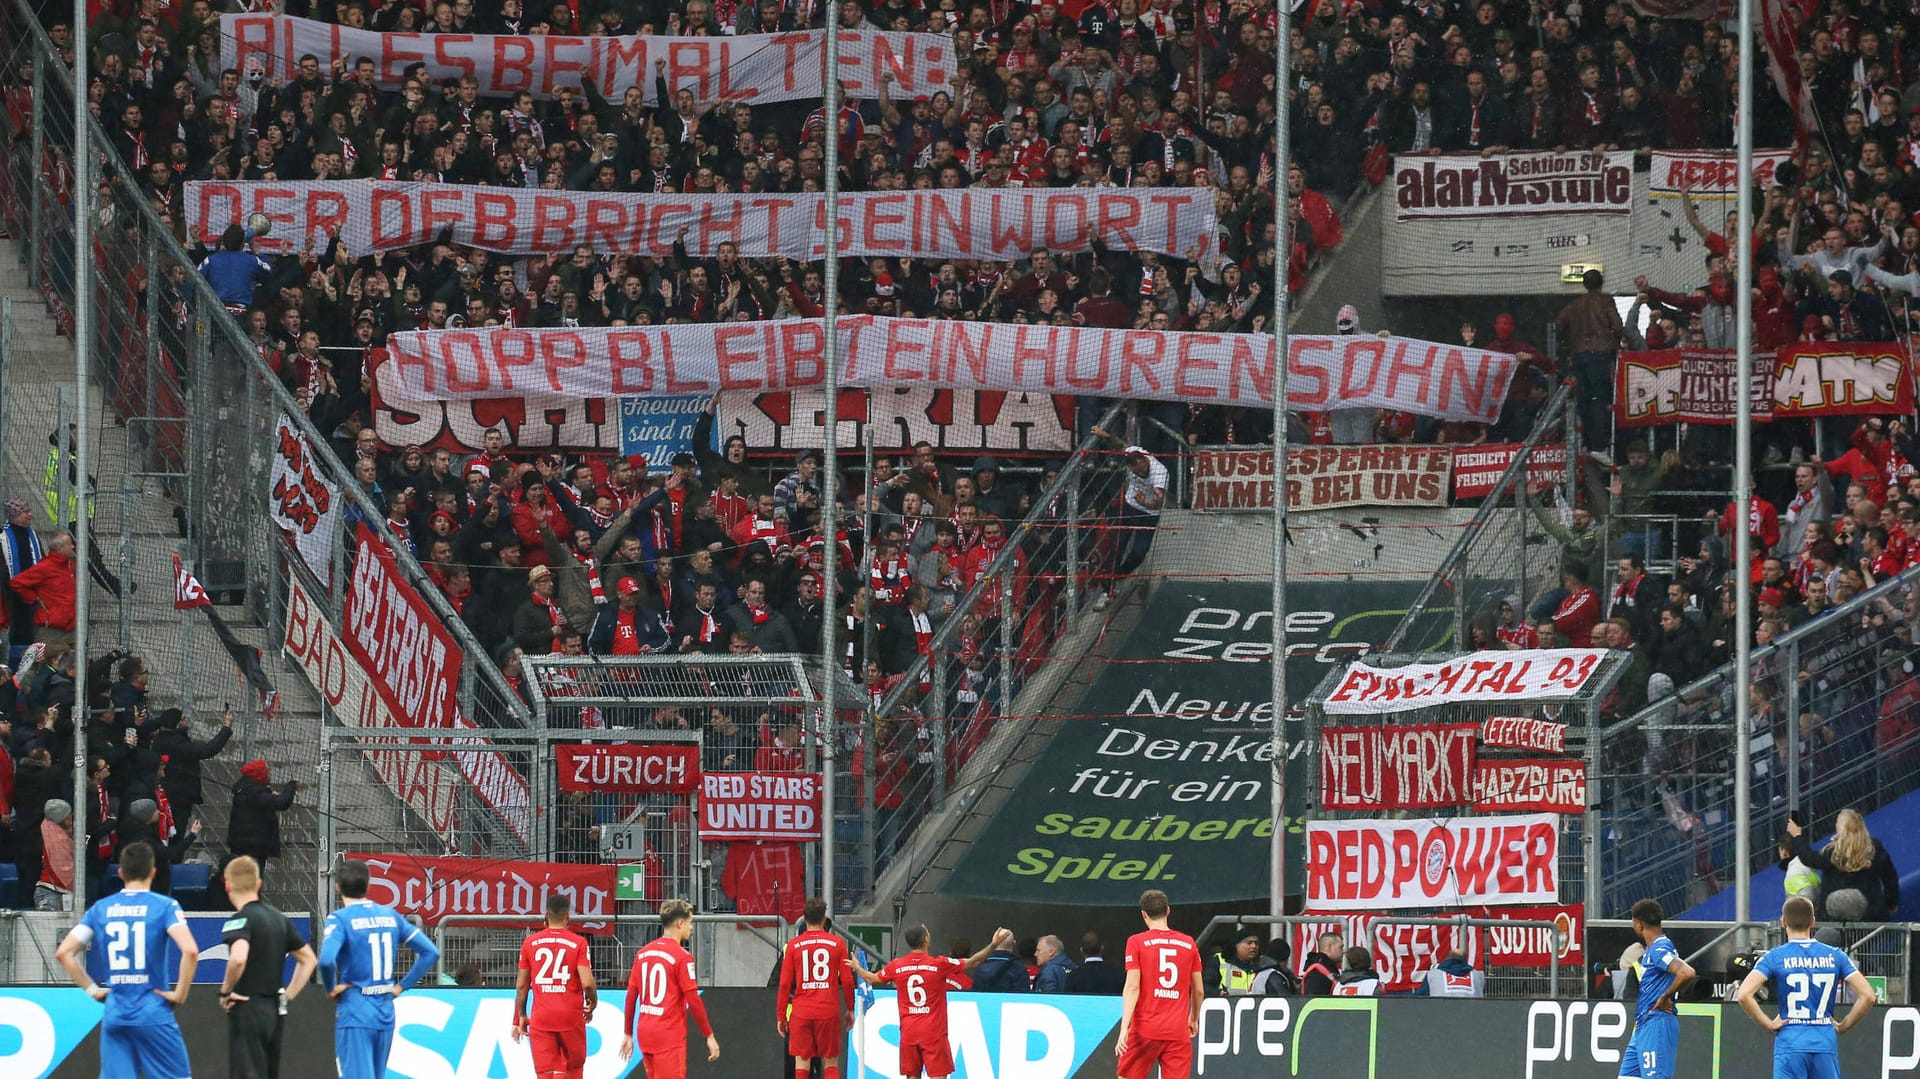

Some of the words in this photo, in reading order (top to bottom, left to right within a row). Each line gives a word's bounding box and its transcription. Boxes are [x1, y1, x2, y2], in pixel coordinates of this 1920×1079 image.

[1510, 154, 1577, 176] Sektion
[200, 184, 350, 251] DER
[371, 188, 518, 251] DFB
[530, 195, 794, 257] BRICHT
[813, 192, 972, 255] SEIN
[390, 330, 587, 394] HOPP
[608, 315, 874, 395] BLEIBT
[884, 320, 991, 385] EIN
[628, 418, 677, 442] sind
[1195, 480, 1302, 509] IMMER
[1312, 472, 1362, 501] BEI
[1372, 472, 1440, 502] UNS
[1178, 607, 1336, 635] pre
[287, 586, 346, 707] BAD
[572, 748, 686, 786] ZÜRICH
[1069, 767, 1160, 801] für
[1170, 775, 1262, 802] ein
[1322, 728, 1477, 806] NEUMARKT
[1472, 765, 1586, 807] HARZBURG
[704, 775, 746, 800] RED
[751, 775, 814, 801] STARS
[707, 804, 815, 831] UNITED
[612, 831, 634, 850] G1
[1007, 847, 1177, 883] Spiel.
[1308, 828, 1387, 900] RED
[1392, 822, 1556, 900] POWER
[105, 920, 147, 971] 21
[368, 931, 394, 982] 11
[801, 947, 830, 982] 18
[1784, 953, 1836, 969] KRAMARIĆ
[535, 947, 571, 985] 24
[641, 961, 667, 1006] 10
[1158, 947, 1179, 989] 5
[907, 974, 927, 1008] 6
[1786, 972, 1836, 1019] 27
[1197, 997, 1291, 1076] pre
[1526, 1000, 1627, 1079] pre
[1642, 1050, 1657, 1068] 31
